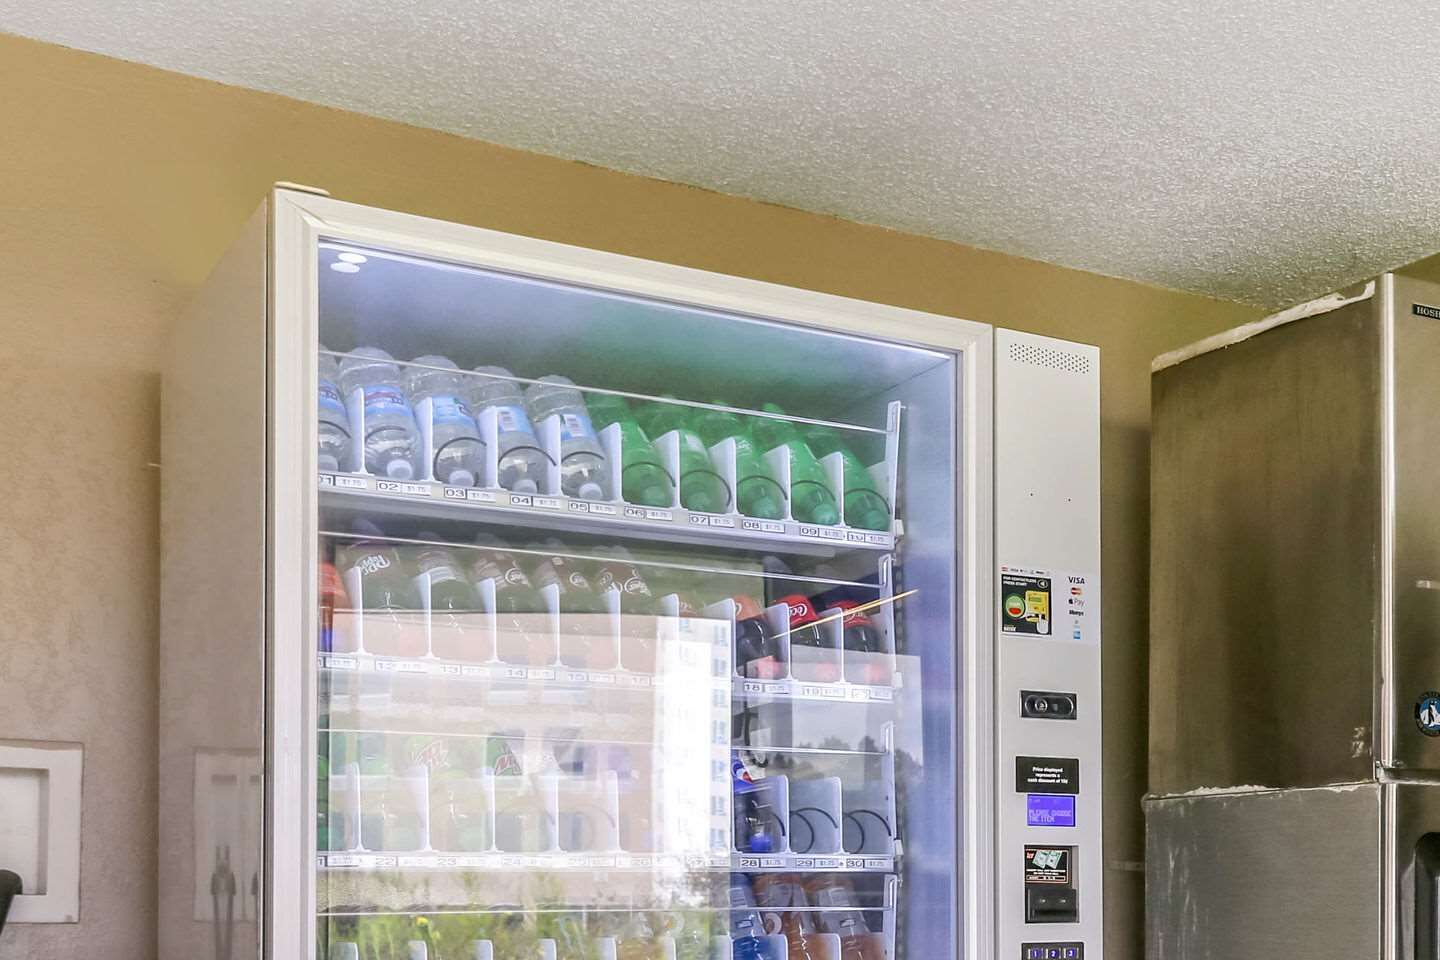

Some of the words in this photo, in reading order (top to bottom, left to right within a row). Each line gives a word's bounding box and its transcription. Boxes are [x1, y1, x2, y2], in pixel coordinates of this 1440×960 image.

[378, 482, 399, 491] 02
[445, 488, 464, 498] 03
[511, 495, 530, 505] 04
[570, 502, 588, 512] 05
[690, 515, 707, 525] 07
[801, 527, 817, 537] 09
[741, 859, 758, 868] 28
[797, 860, 813, 868] 29
[847, 859, 862, 868] 30
